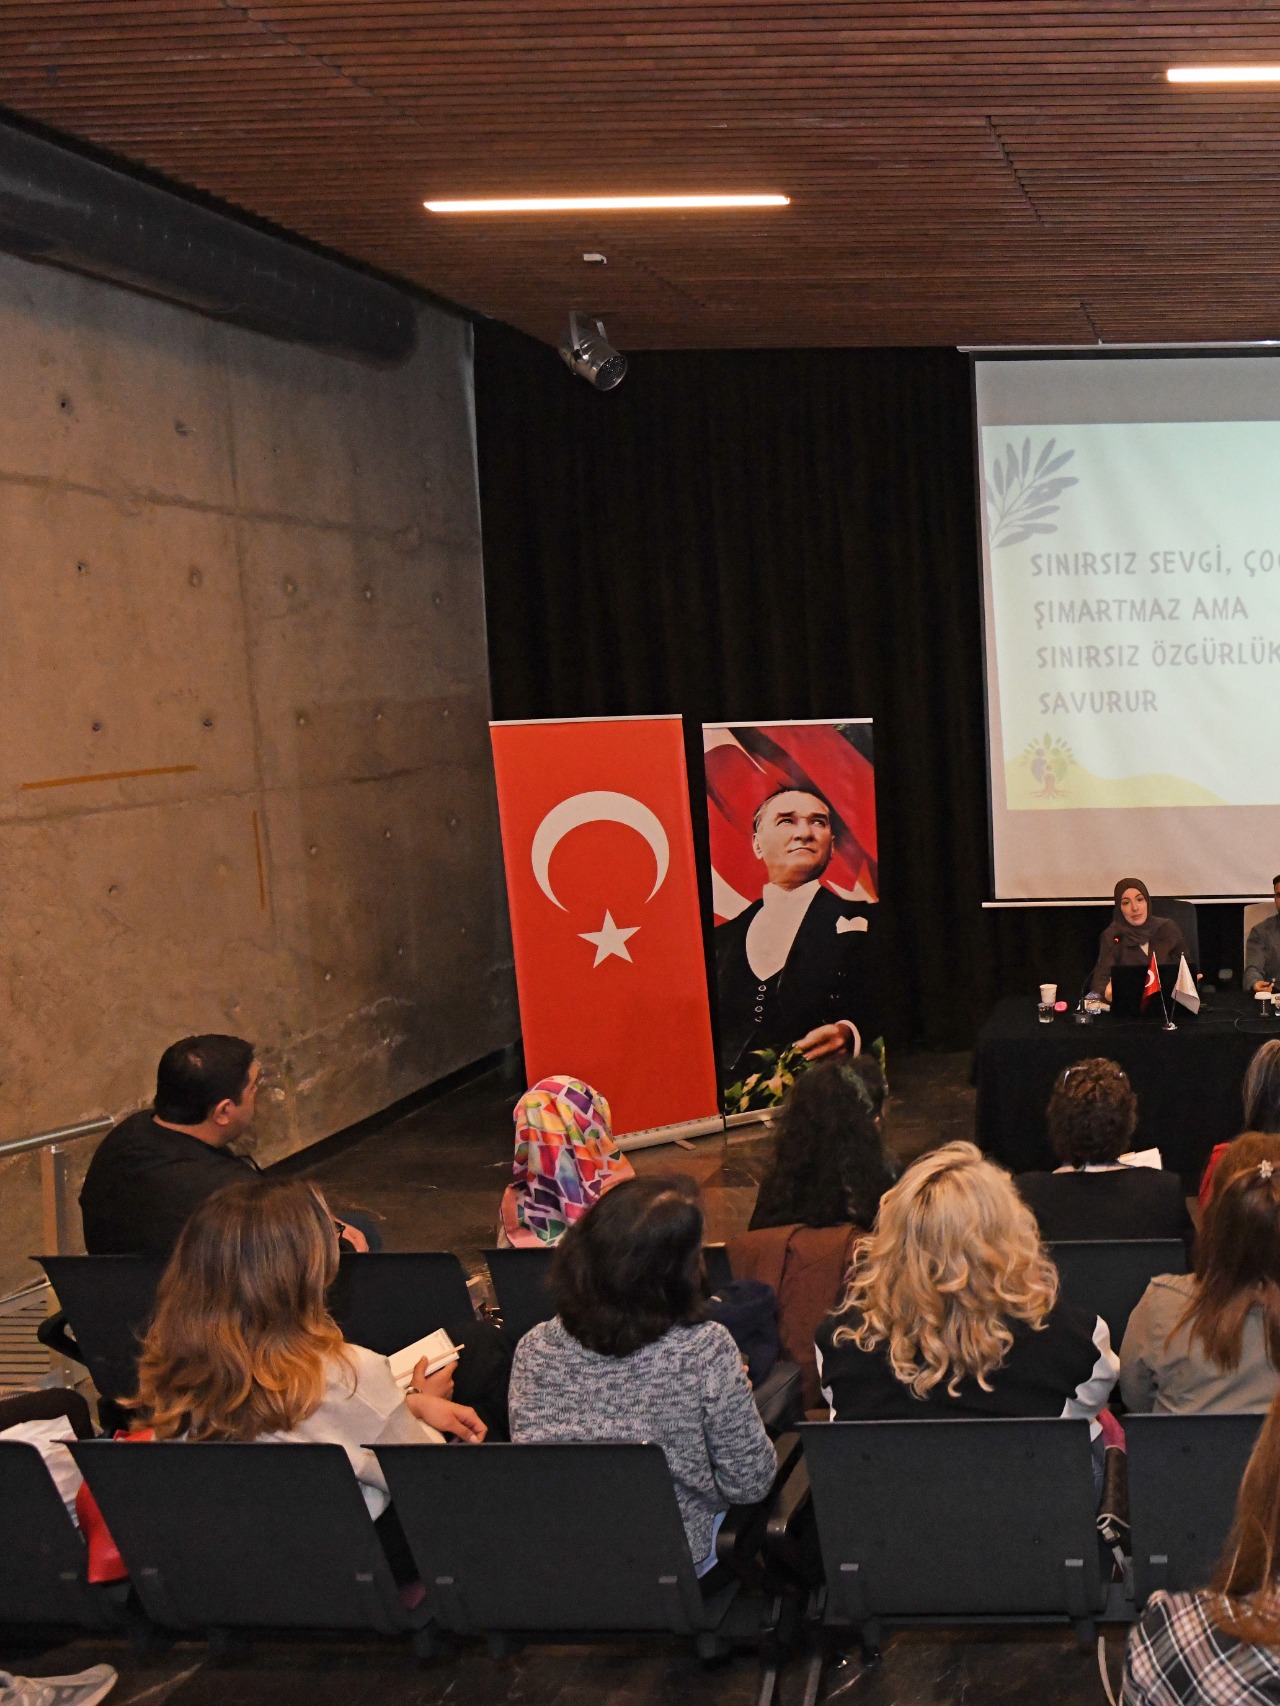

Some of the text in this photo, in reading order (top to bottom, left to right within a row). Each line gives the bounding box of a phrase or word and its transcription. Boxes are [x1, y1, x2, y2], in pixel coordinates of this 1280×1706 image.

[1030, 551, 1137, 576] SINIRSIZ
[1149, 544, 1232, 576] SEVGİ,
[1034, 597, 1249, 630] ŞIMARTMAZ AMA
[1036, 645, 1140, 669] SINIRSIZ
[1039, 690, 1158, 715] SAVURUR
